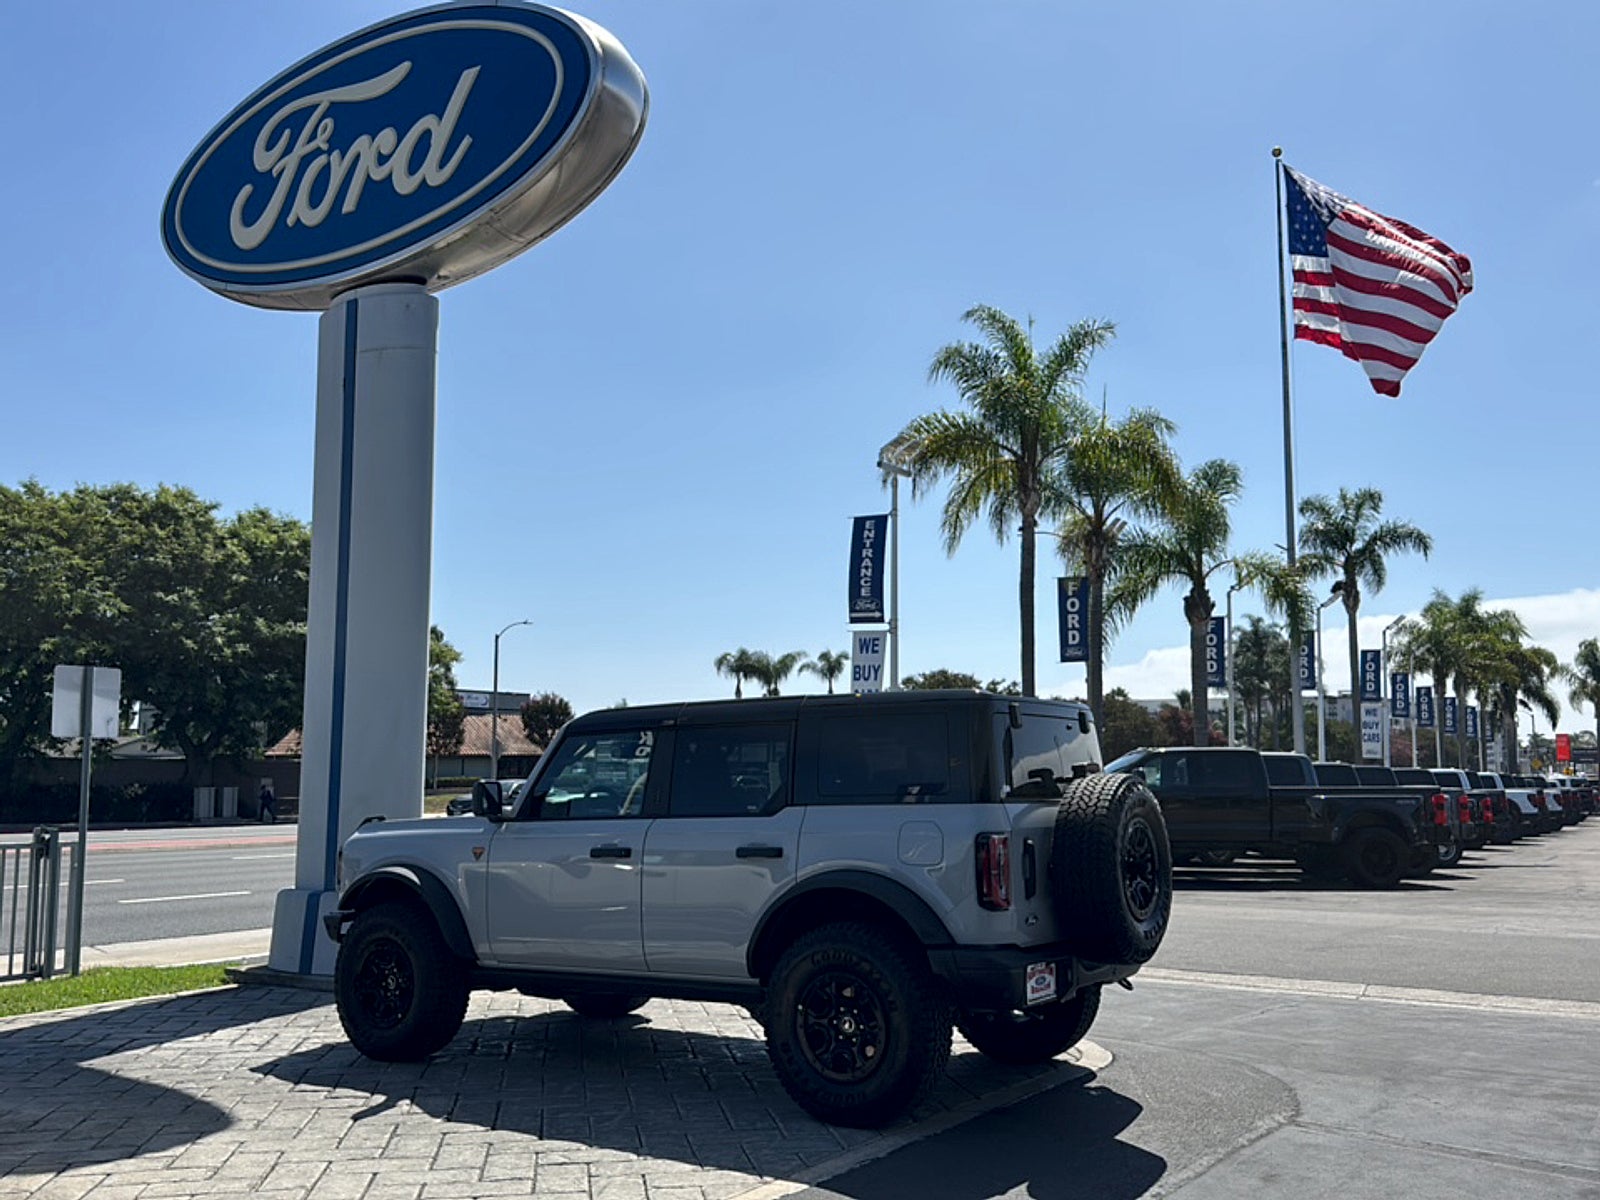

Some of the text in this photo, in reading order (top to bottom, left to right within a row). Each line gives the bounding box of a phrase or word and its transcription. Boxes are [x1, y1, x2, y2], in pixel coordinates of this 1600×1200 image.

[229, 60, 482, 251] Ford
[859, 520, 875, 597] ENTRANCE
[1066, 581, 1081, 645] FORD
[858, 637, 880, 655] WE
[1206, 621, 1217, 673] FORD
[853, 664, 881, 682] BUY
[1366, 652, 1375, 691] FORD
[1396, 675, 1405, 709] FORD
[1419, 689, 1429, 719] FORD
[1363, 720, 1380, 730] BUY
[1365, 708, 1378, 717] WE
[1363, 732, 1380, 743] CARS
